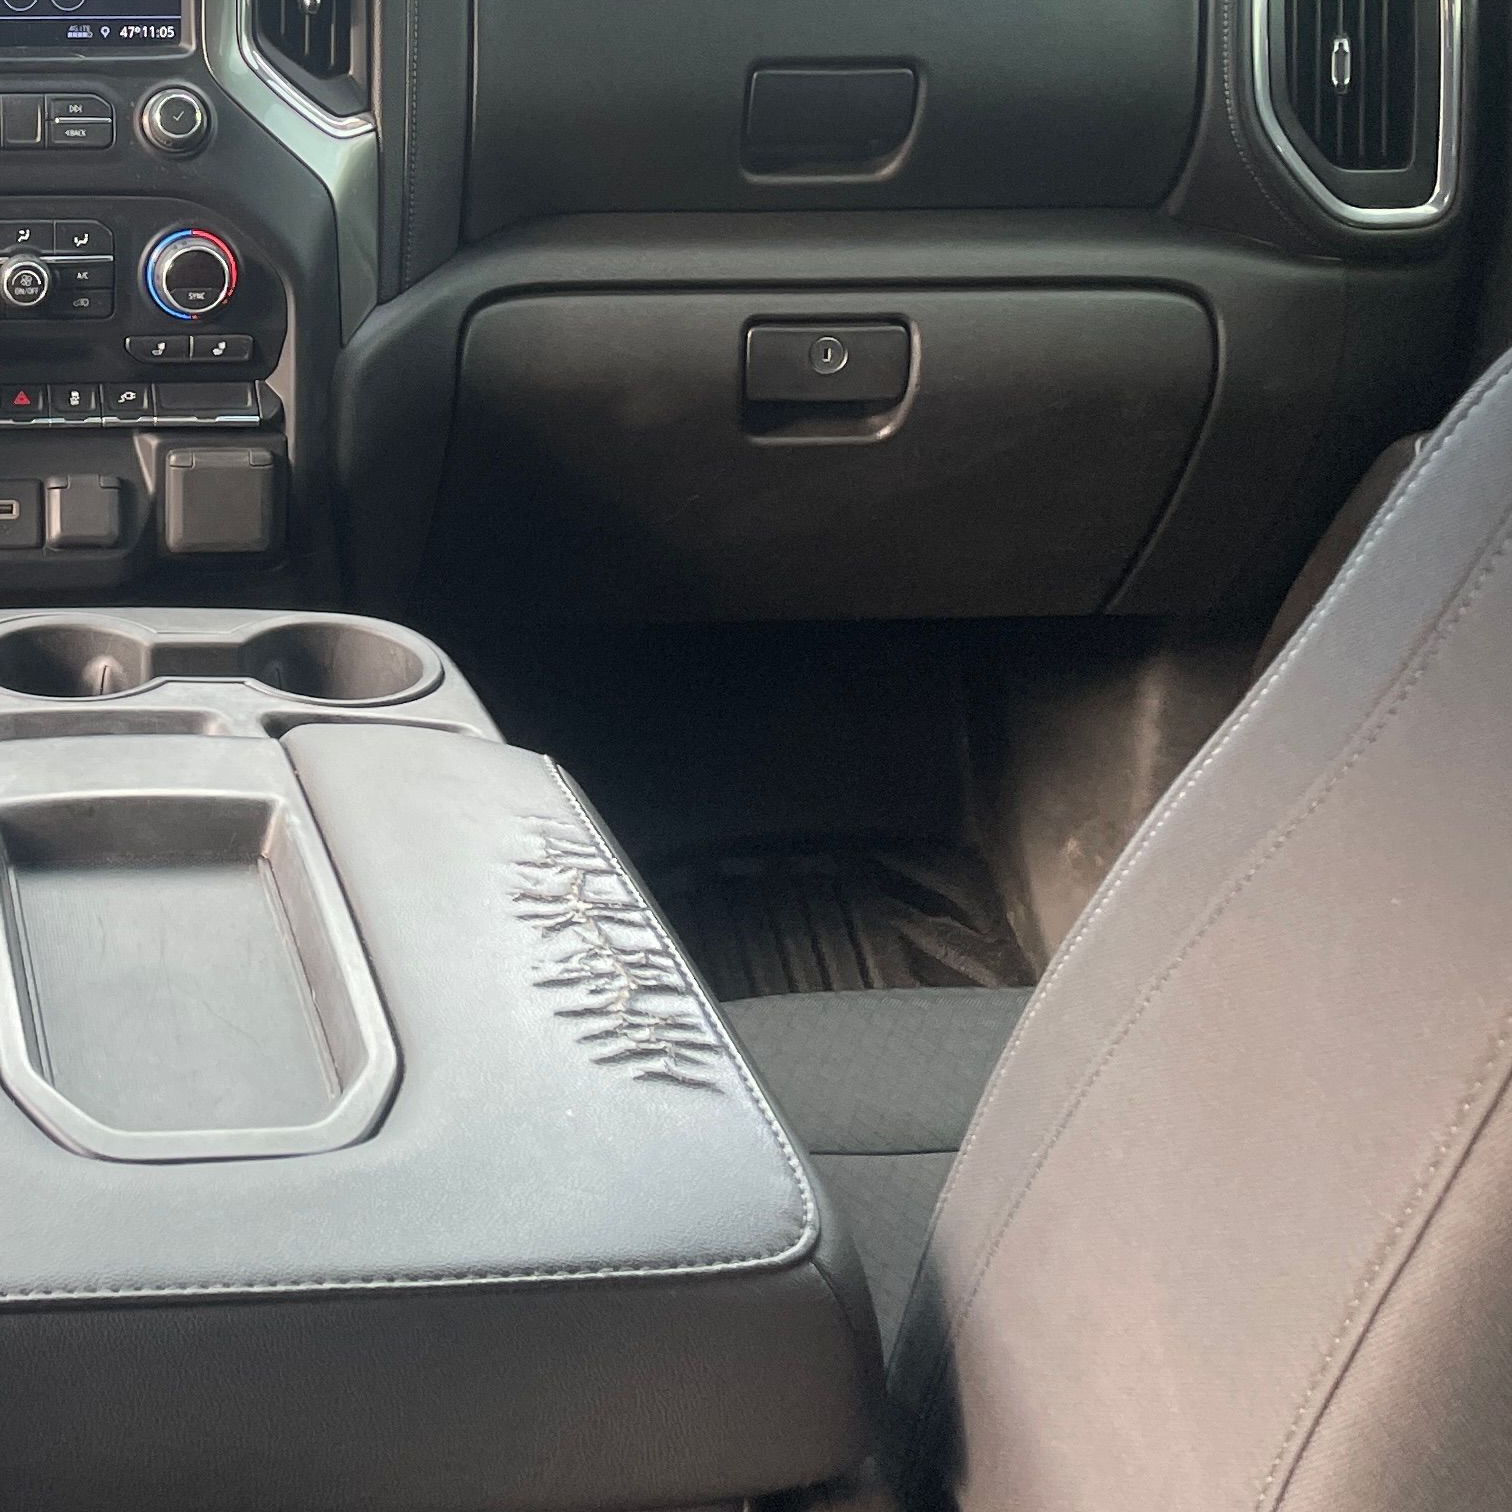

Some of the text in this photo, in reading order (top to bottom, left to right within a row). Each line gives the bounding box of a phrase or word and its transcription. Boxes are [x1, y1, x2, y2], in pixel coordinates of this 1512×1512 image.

[143, 25, 175, 38] 11:05
[70, 129, 87, 137] BACK
[76, 271, 89, 280] A/C
[14, 287, 39, 295] ON/OFF
[188, 291, 206, 301] SYNC
